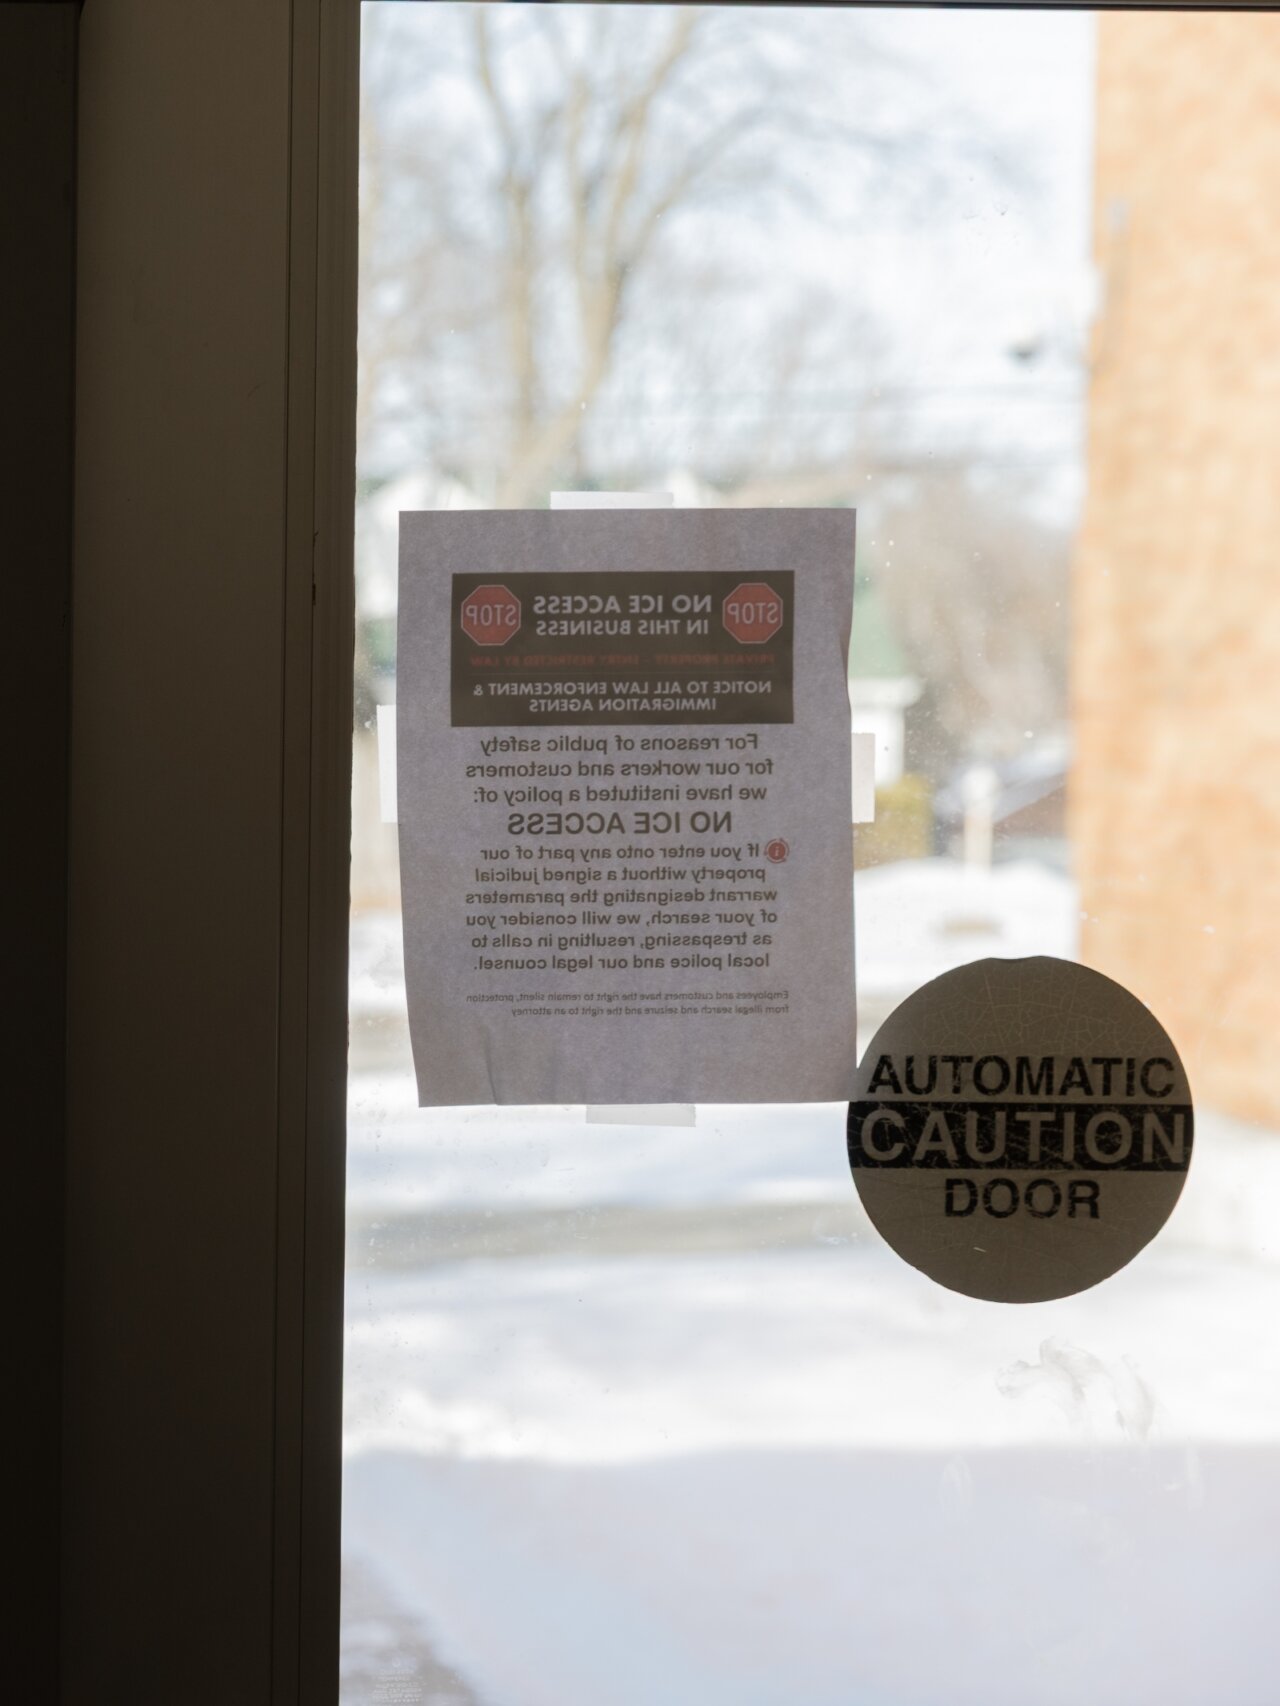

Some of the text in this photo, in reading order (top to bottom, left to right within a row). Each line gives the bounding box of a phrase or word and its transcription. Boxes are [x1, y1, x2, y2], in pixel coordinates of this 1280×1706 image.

[867, 1055, 1175, 1098] AUTOMATIC
[860, 1109, 1185, 1164] CAUTION
[944, 1178, 1101, 1219] DOOR
